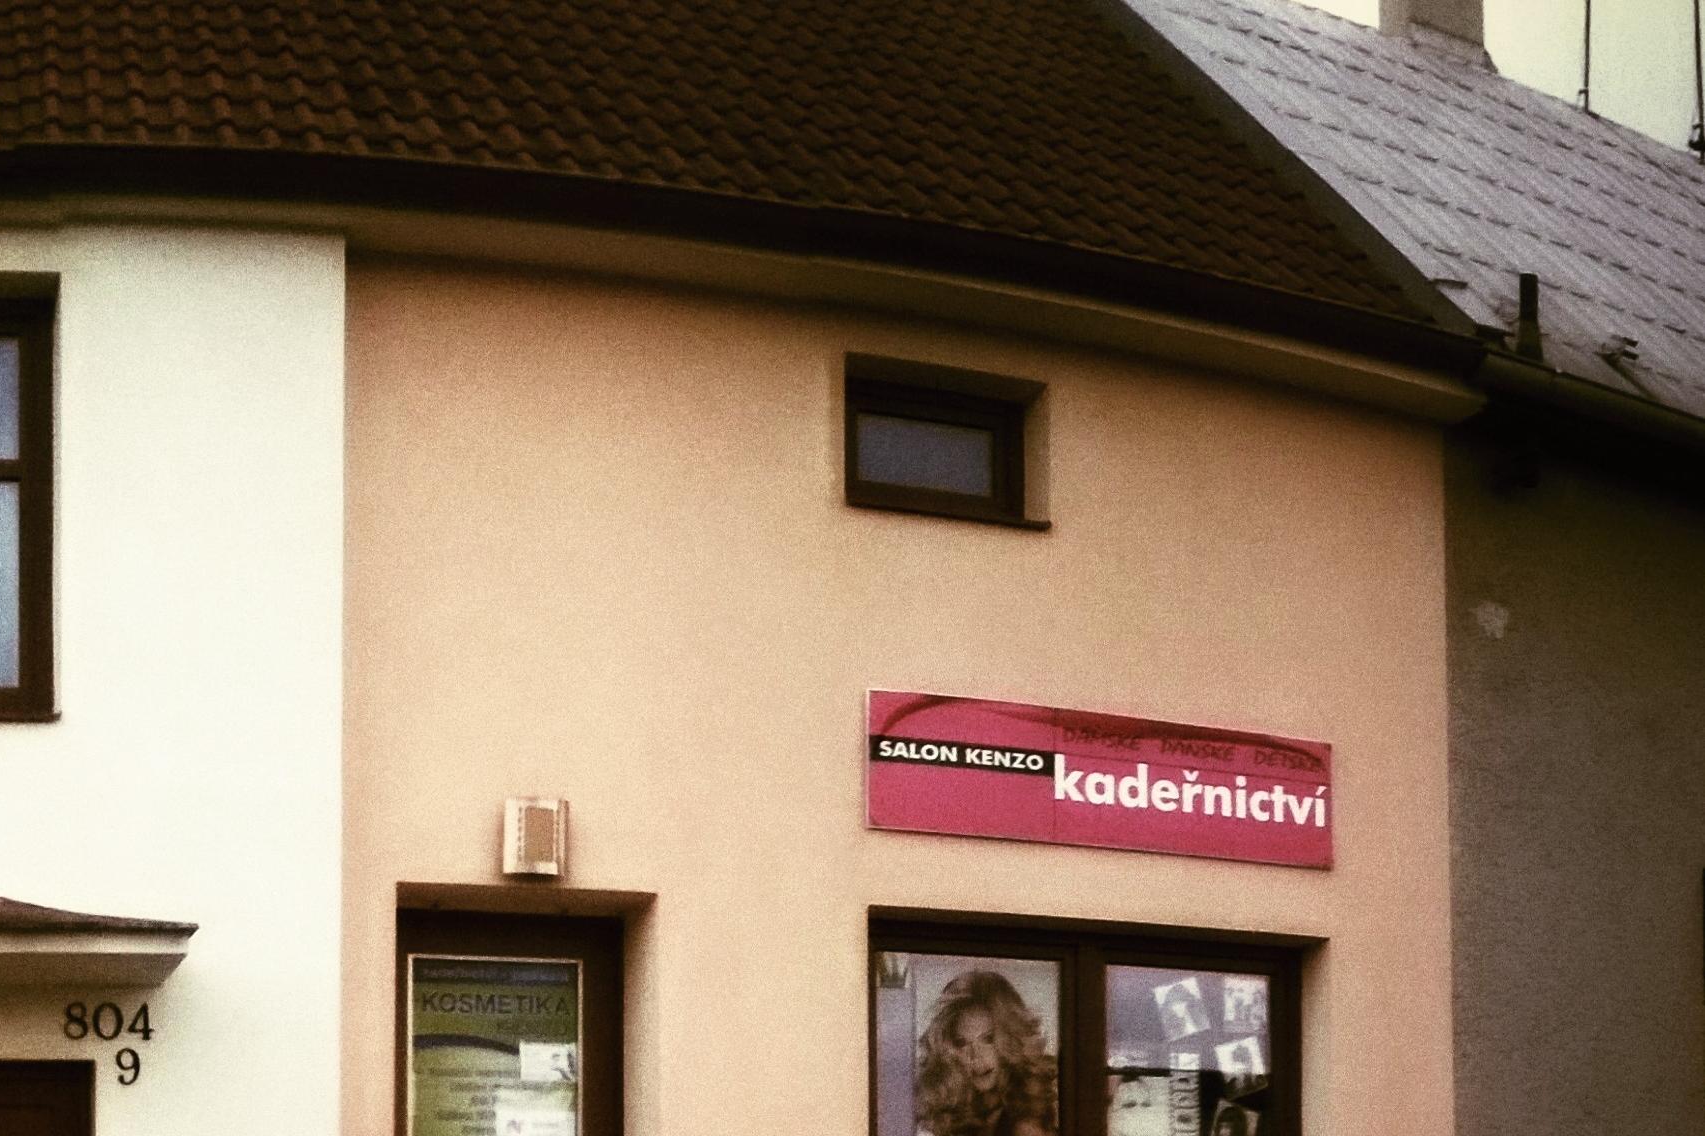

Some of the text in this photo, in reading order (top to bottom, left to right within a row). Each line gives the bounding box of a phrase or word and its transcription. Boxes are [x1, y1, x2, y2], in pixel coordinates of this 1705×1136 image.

[879, 740, 1045, 771] SALON KENZO
[1054, 753, 1327, 828] kadeřnictví
[63, 1001, 155, 1041] 804
[421, 991, 570, 1017] KOSMETIKA
[115, 1047, 140, 1086] 9
